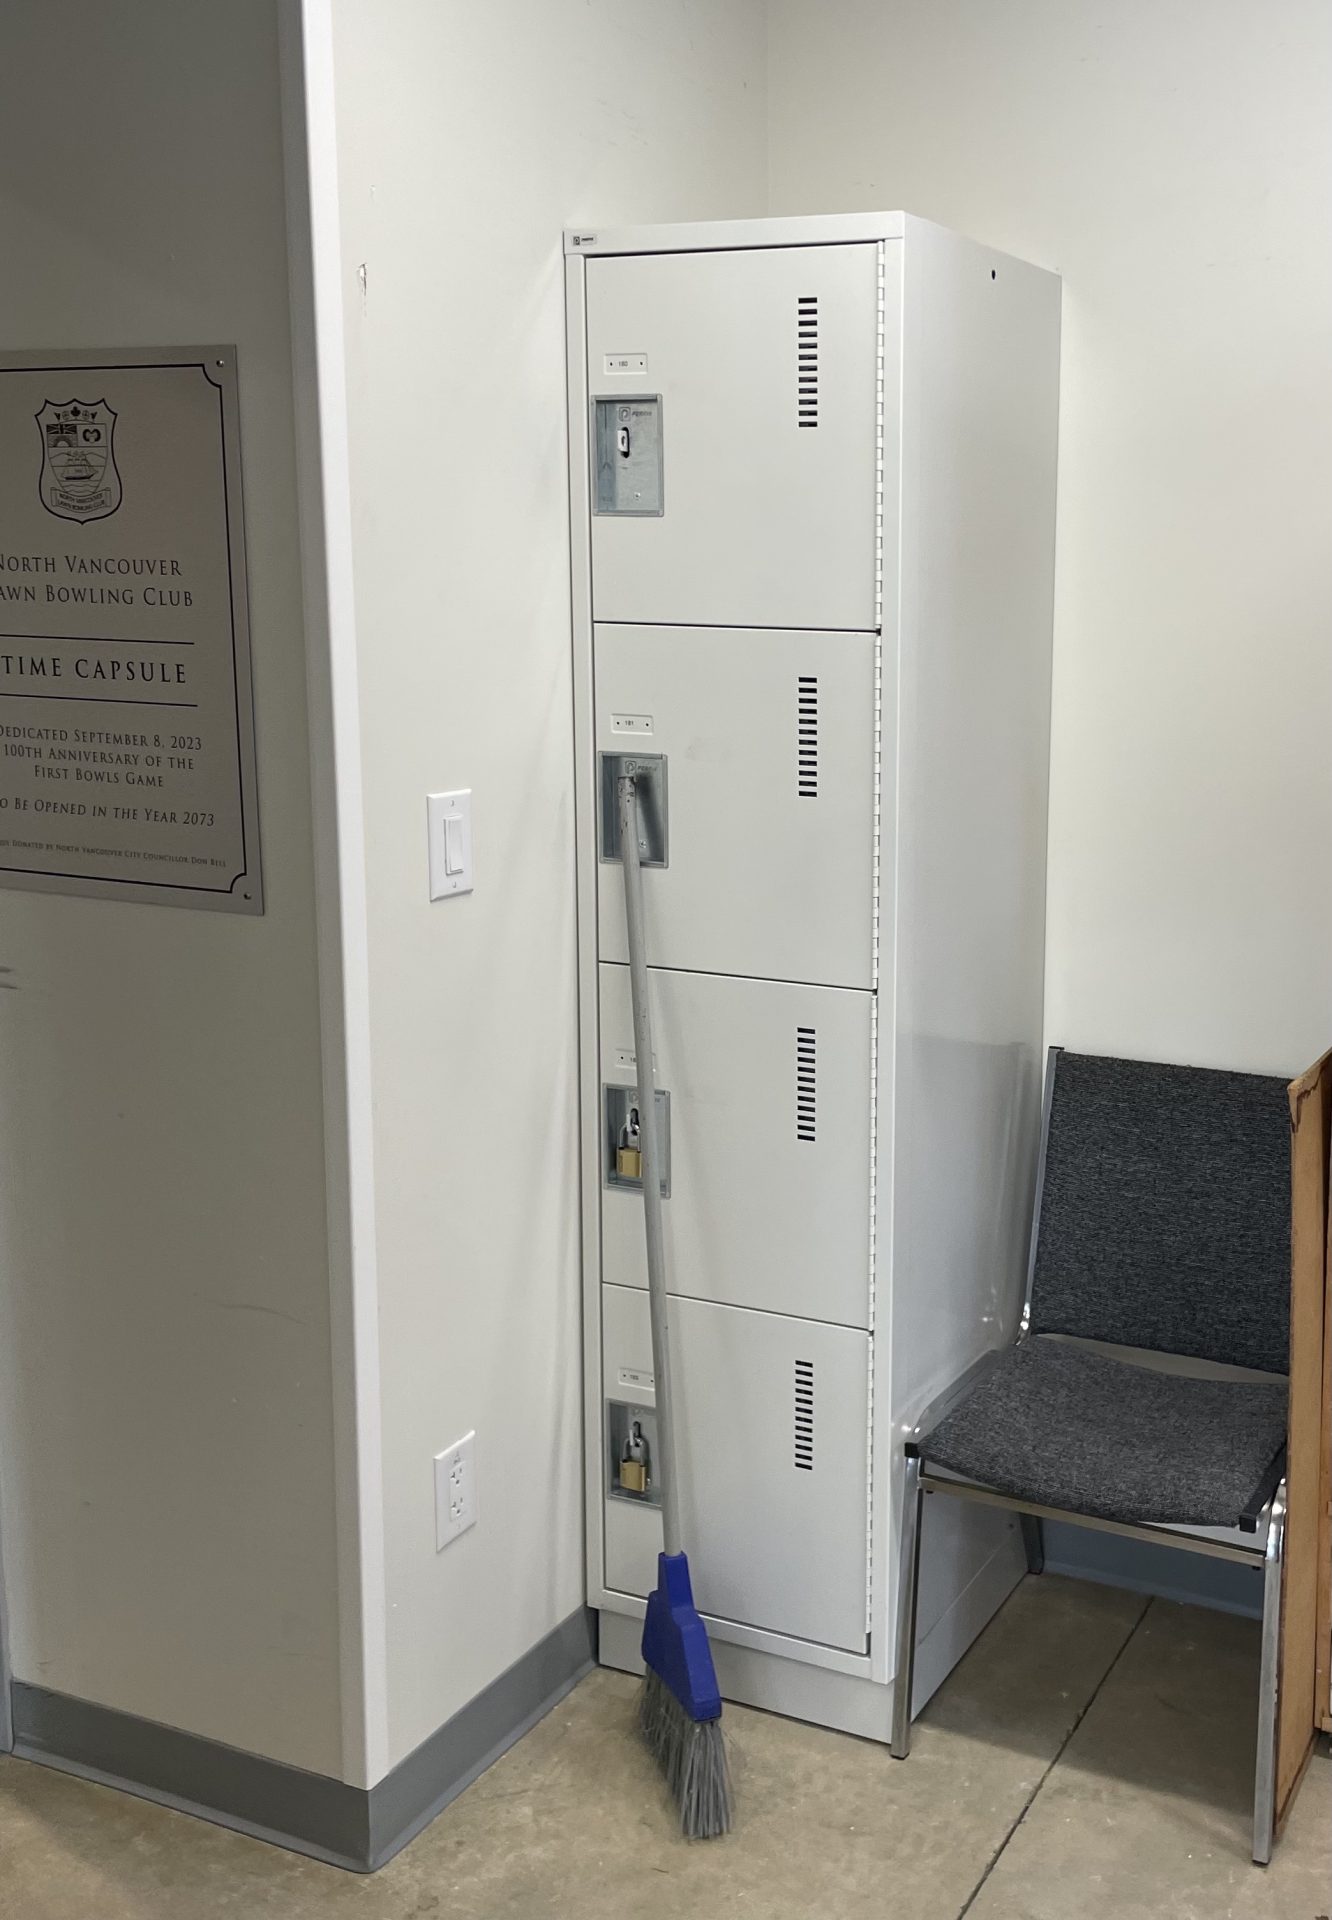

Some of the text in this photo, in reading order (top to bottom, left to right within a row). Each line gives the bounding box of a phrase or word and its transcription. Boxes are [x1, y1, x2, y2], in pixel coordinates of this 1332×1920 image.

[65, 555, 182, 576] VANCOUVER
[0, 584, 193, 607] AWN BOWLING CLUB
[1, 655, 186, 684] TIME CAPSULE
[74, 729, 148, 747] SEPTEMBER
[170, 735, 202, 751] 2023
[4, 744, 194, 770] 100TH ANNIVERSARY OF THE
[34, 765, 164, 788] FIRST BOWLS GAME
[0, 797, 215, 827] O BE OPENED IN THE YEAR 2073
